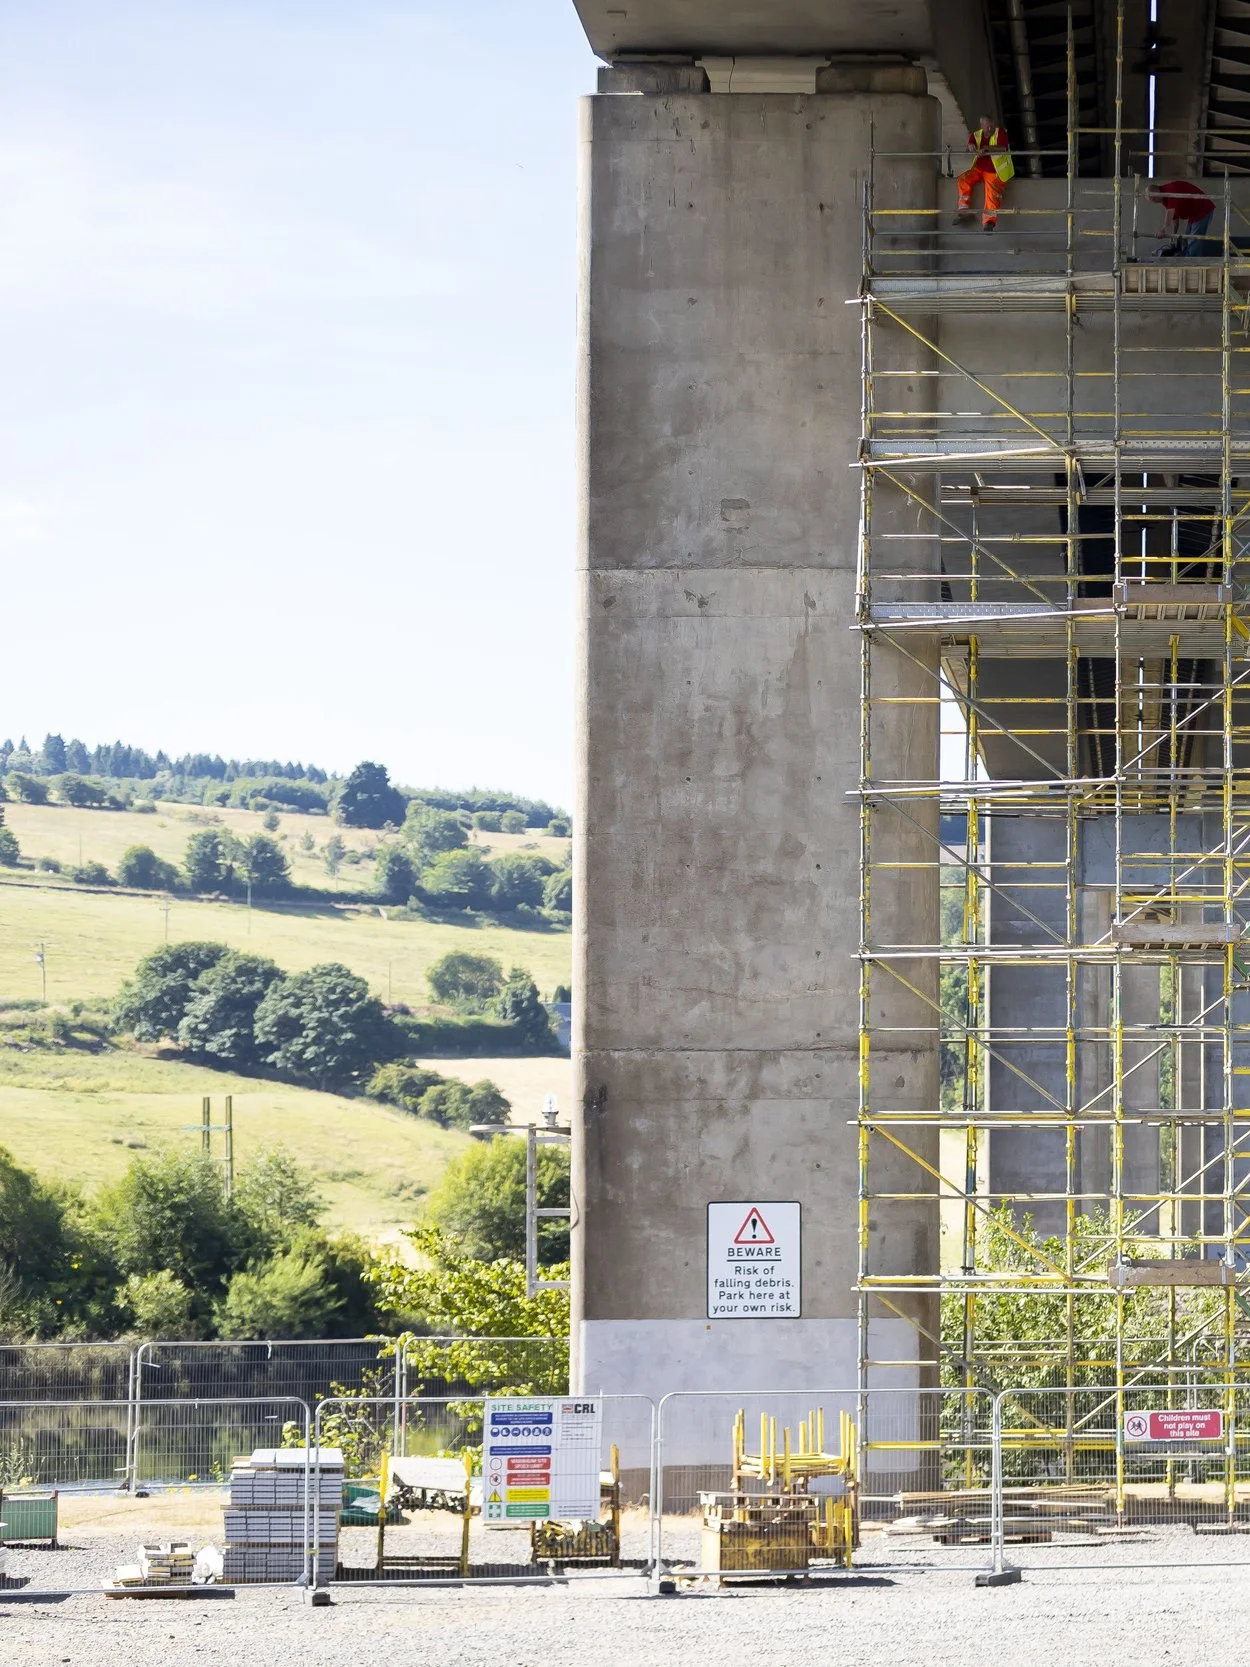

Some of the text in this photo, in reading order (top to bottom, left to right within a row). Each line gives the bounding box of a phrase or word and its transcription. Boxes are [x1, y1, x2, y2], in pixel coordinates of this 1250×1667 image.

[727, 1247, 781, 1257] BEWARE
[734, 1265, 775, 1275] Risk of
[714, 1278, 794, 1289] falling debris.
[718, 1290, 791, 1300] Park here at
[713, 1304, 738, 1314] your
[770, 1303, 796, 1312] risk.
[516, 1403, 553, 1411] SAFETY
[574, 1403, 596, 1414] CRL
[1158, 1413, 1211, 1422] Children must
[1178, 1422, 1194, 1431] play
